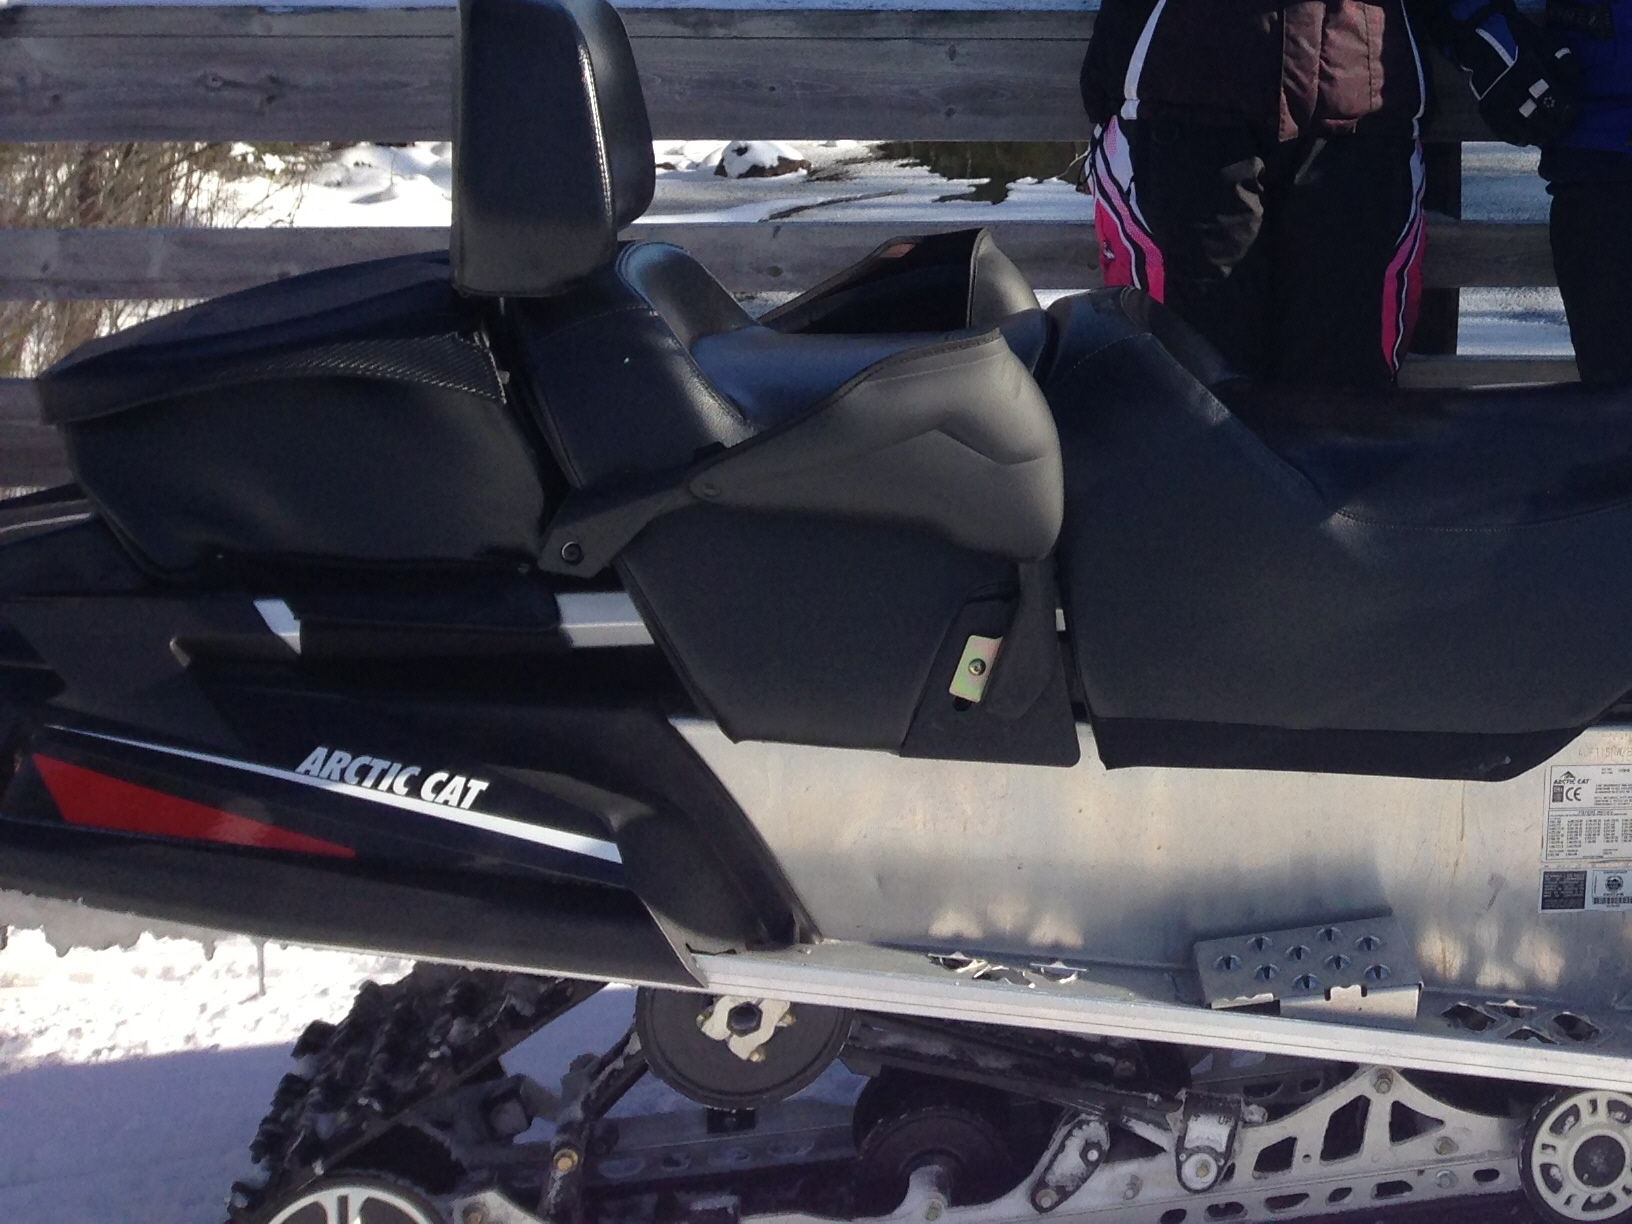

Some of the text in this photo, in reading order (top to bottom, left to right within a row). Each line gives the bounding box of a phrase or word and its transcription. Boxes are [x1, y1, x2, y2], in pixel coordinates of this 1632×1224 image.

[295, 746, 490, 810] ARCTIC CAT
[1565, 786, 1582, 802] CE
